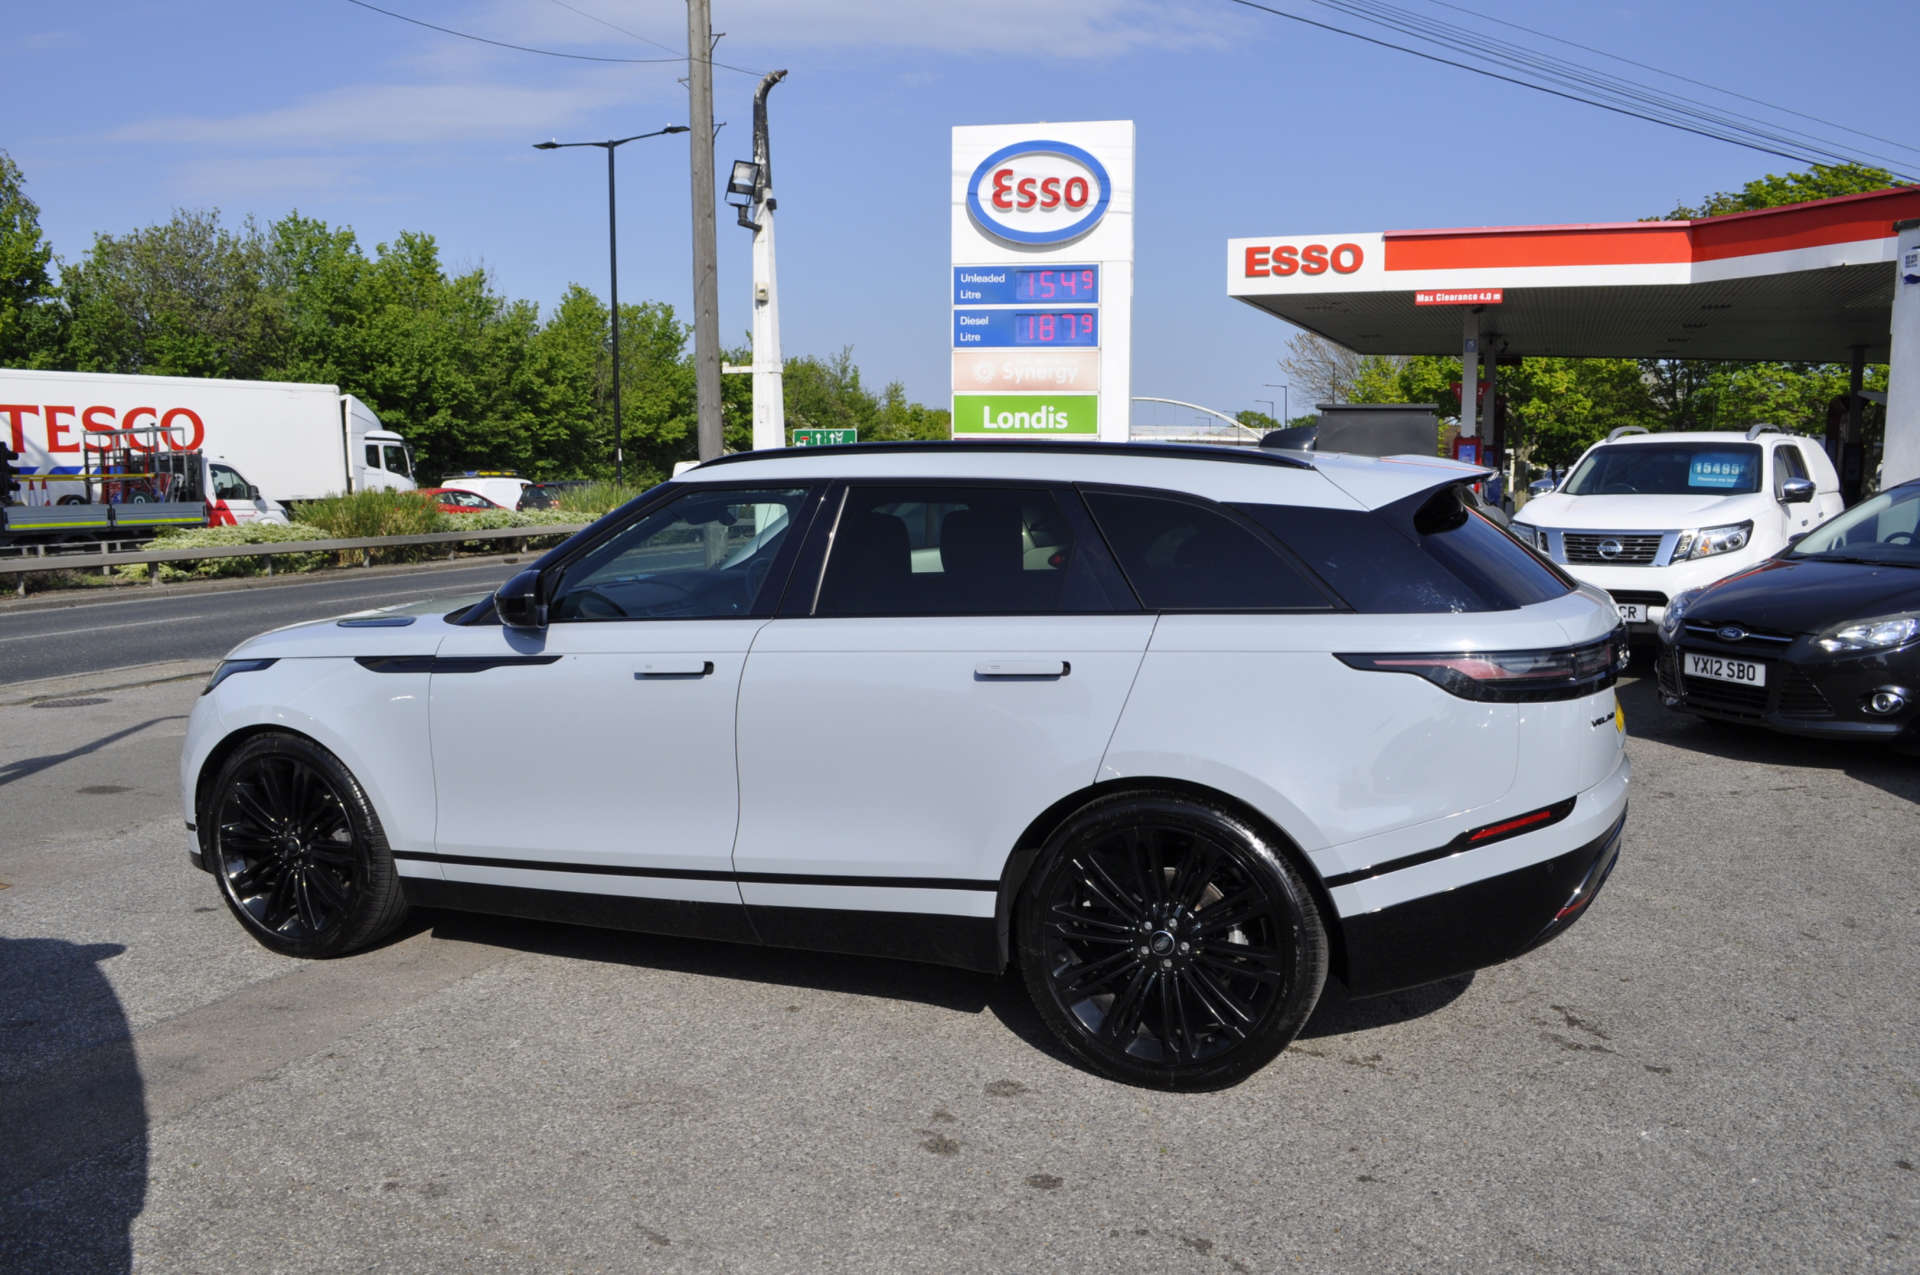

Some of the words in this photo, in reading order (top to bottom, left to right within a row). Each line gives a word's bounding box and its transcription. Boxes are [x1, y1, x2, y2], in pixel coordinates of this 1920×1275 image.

[992, 168, 1089, 209] Esso
[1245, 243, 1364, 278] ESSO
[960, 273, 1005, 283] Unleaded
[960, 290, 981, 299] Litre
[1416, 294, 1434, 302] Max
[1436, 293, 1478, 301] Clearance
[960, 316, 989, 325] Diesel
[960, 332, 981, 342] Litre
[983, 405, 1069, 429] Londis
[0, 404, 205, 454] TESCO
[1692, 656, 1722, 677] YX12
[1726, 662, 1756, 681] SBO
